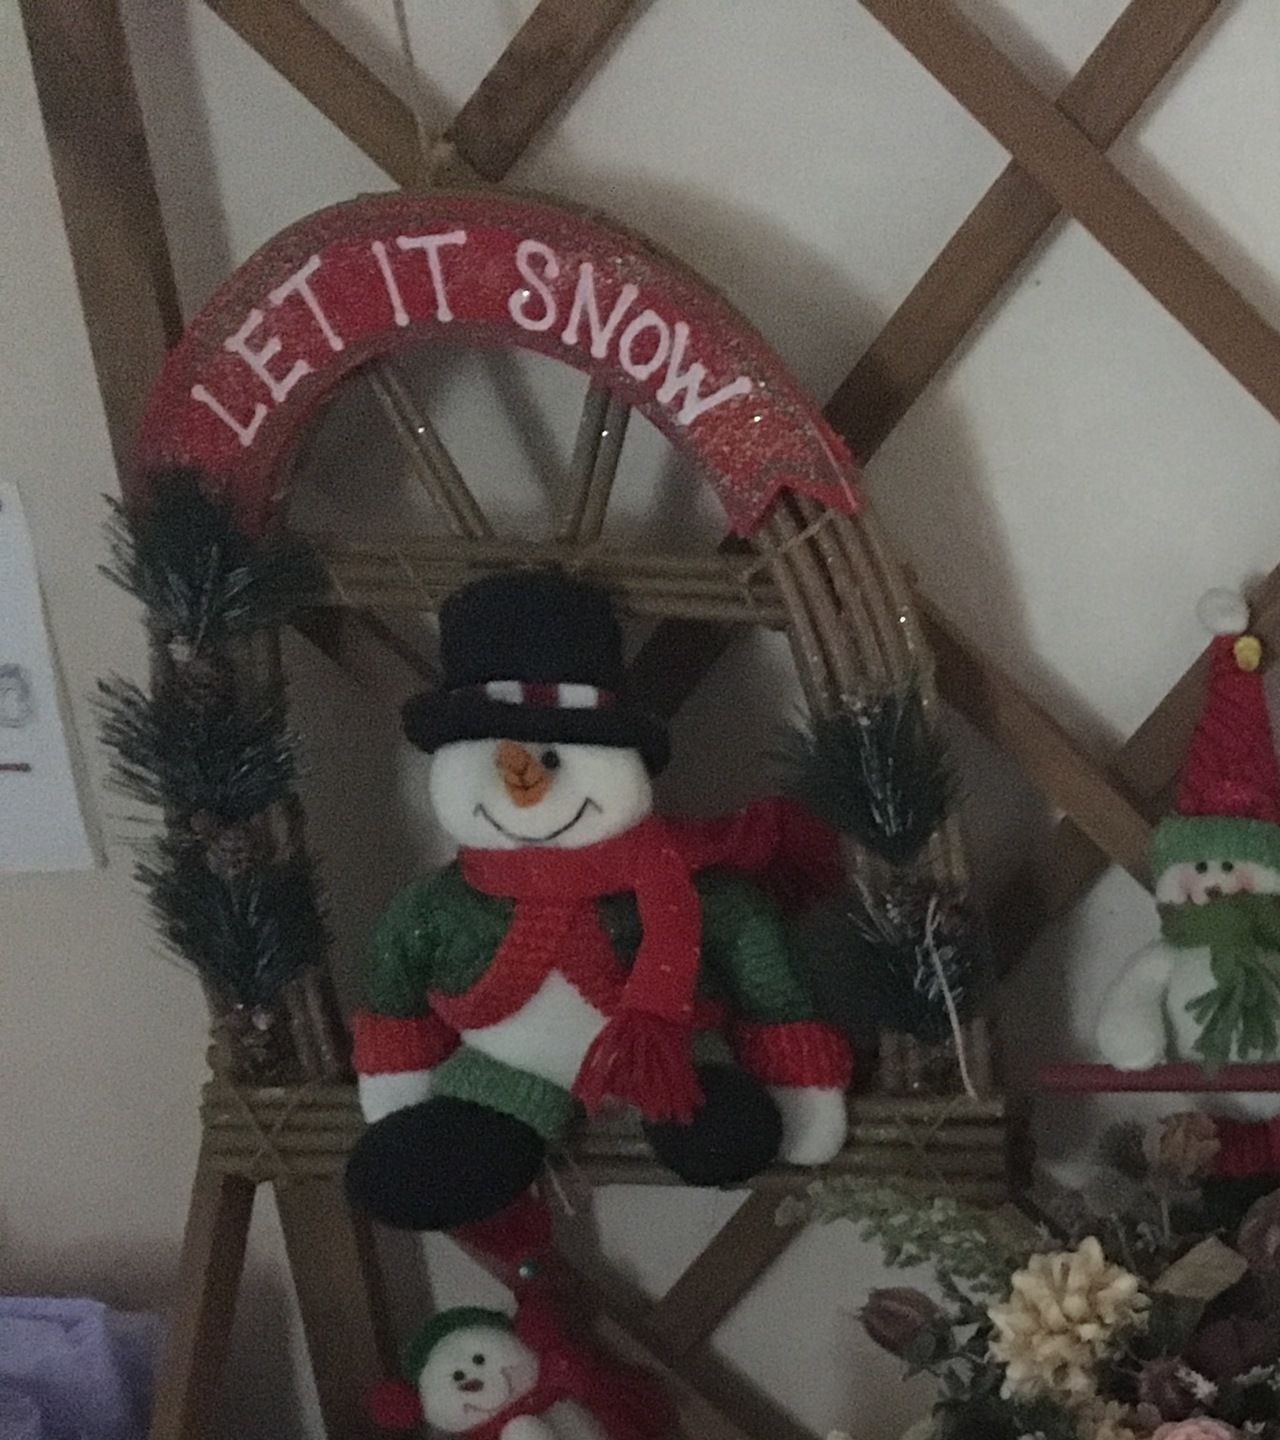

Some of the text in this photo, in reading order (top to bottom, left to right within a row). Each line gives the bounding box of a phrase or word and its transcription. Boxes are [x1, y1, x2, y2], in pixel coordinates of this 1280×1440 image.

[192, 230, 751, 446] LET IT SNOW
